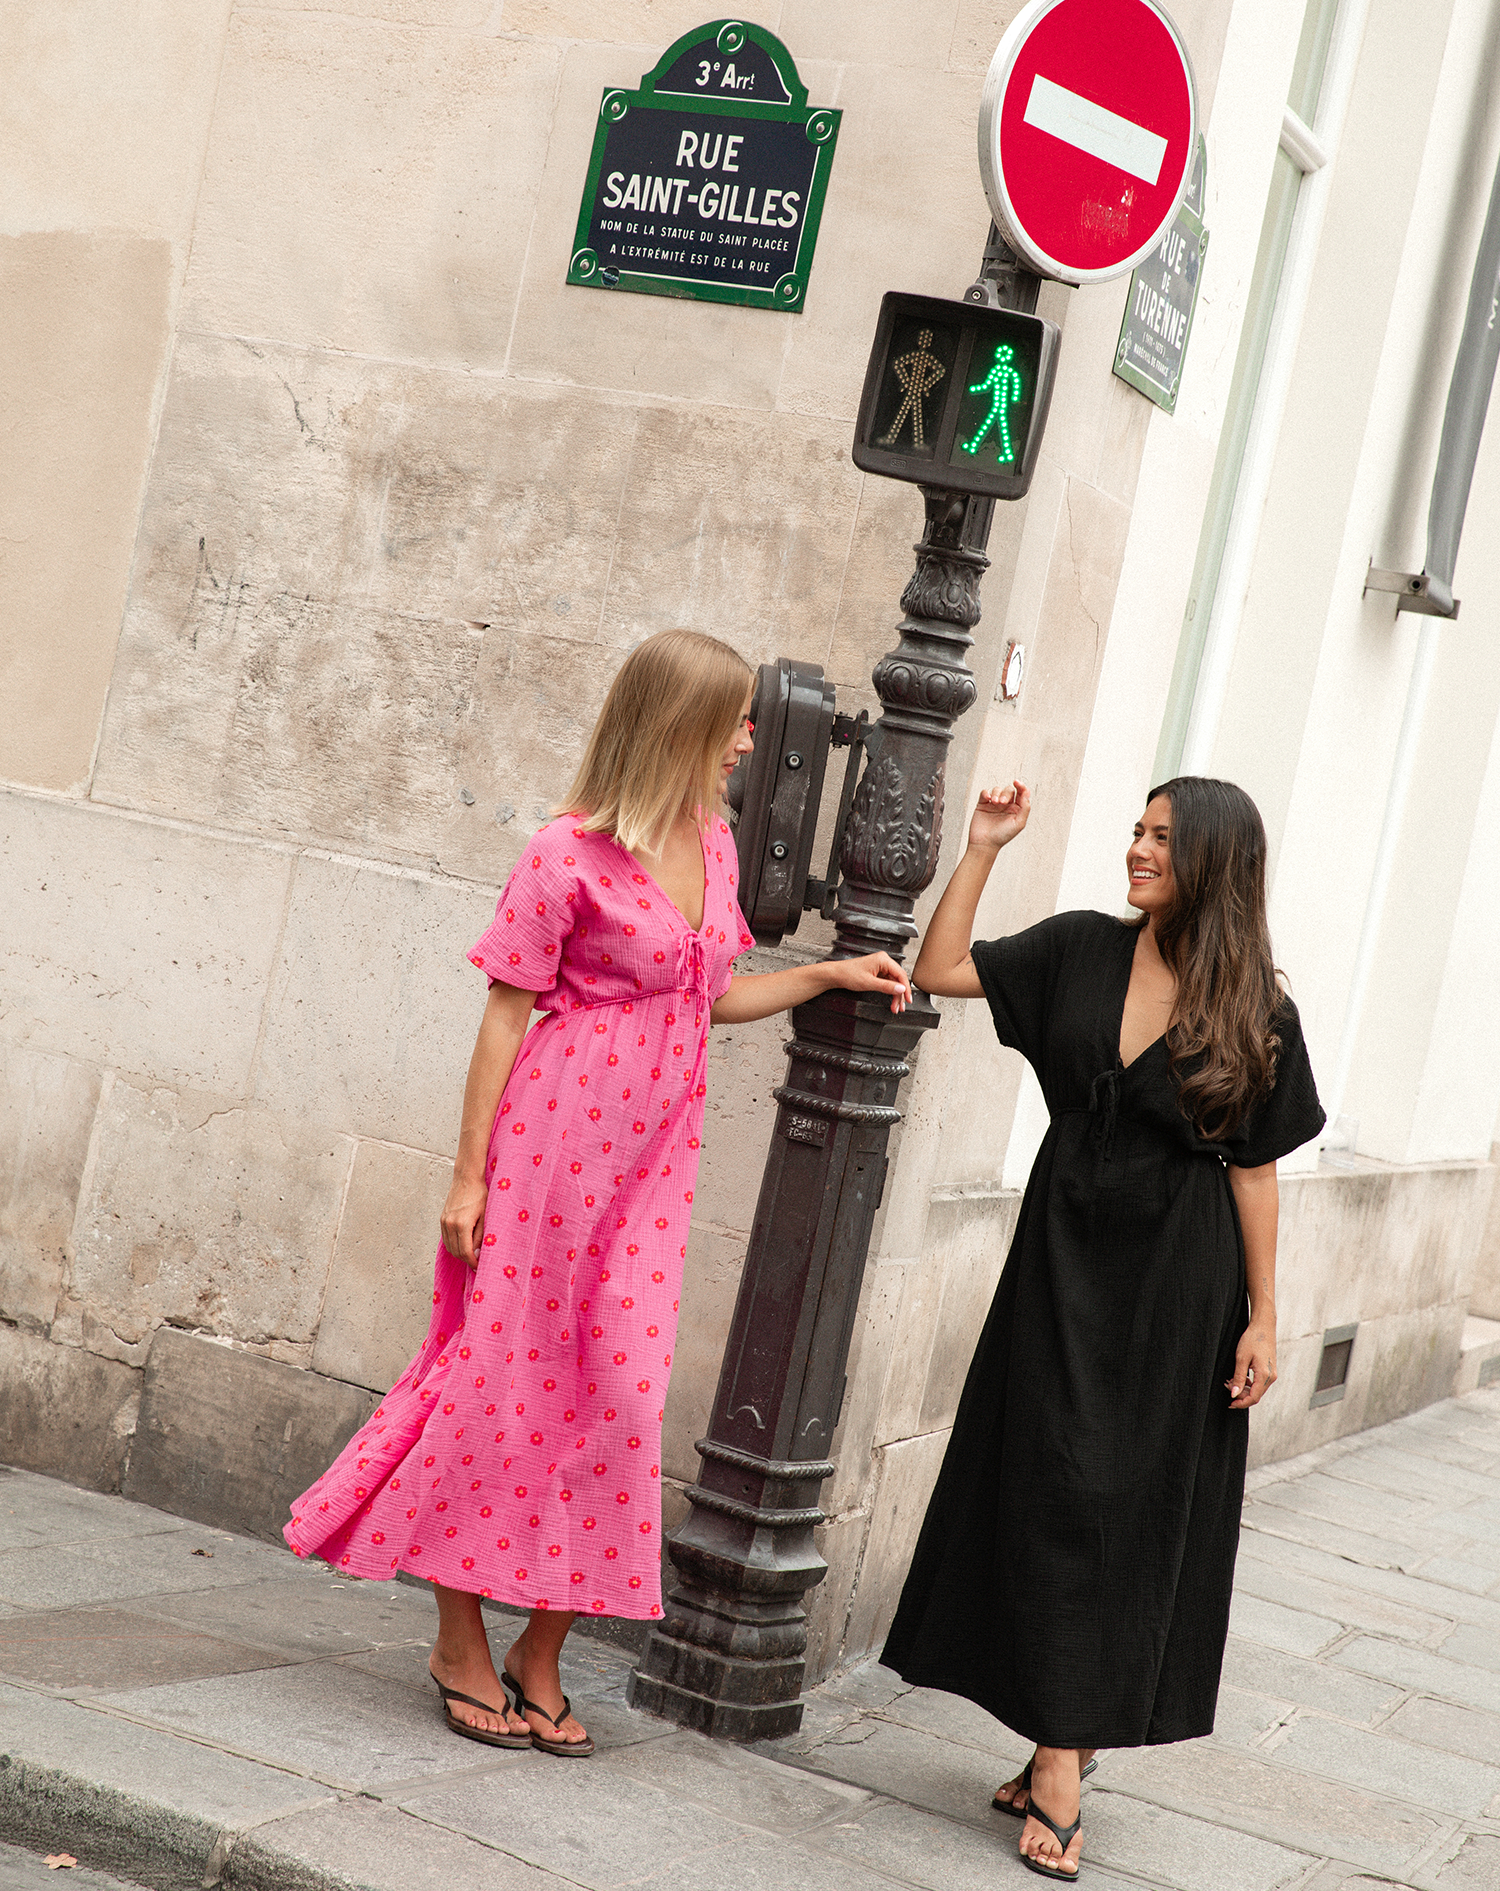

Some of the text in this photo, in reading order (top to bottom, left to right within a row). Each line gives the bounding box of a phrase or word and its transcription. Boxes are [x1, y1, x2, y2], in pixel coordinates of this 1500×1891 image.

[676, 130, 744, 172] RUE
[602, 171, 800, 228] SAINT-GILLES
[600, 219, 789, 252] NOM DE LA STATUE DU SAINT PLACÉE
[1160, 229, 1187, 275] RUE
[609, 243, 771, 273] A L'EXTRÉMITÉ EST DE LA RUE
[1161, 271, 1172, 294] DE
[1134, 279, 1187, 350] TURENNE
